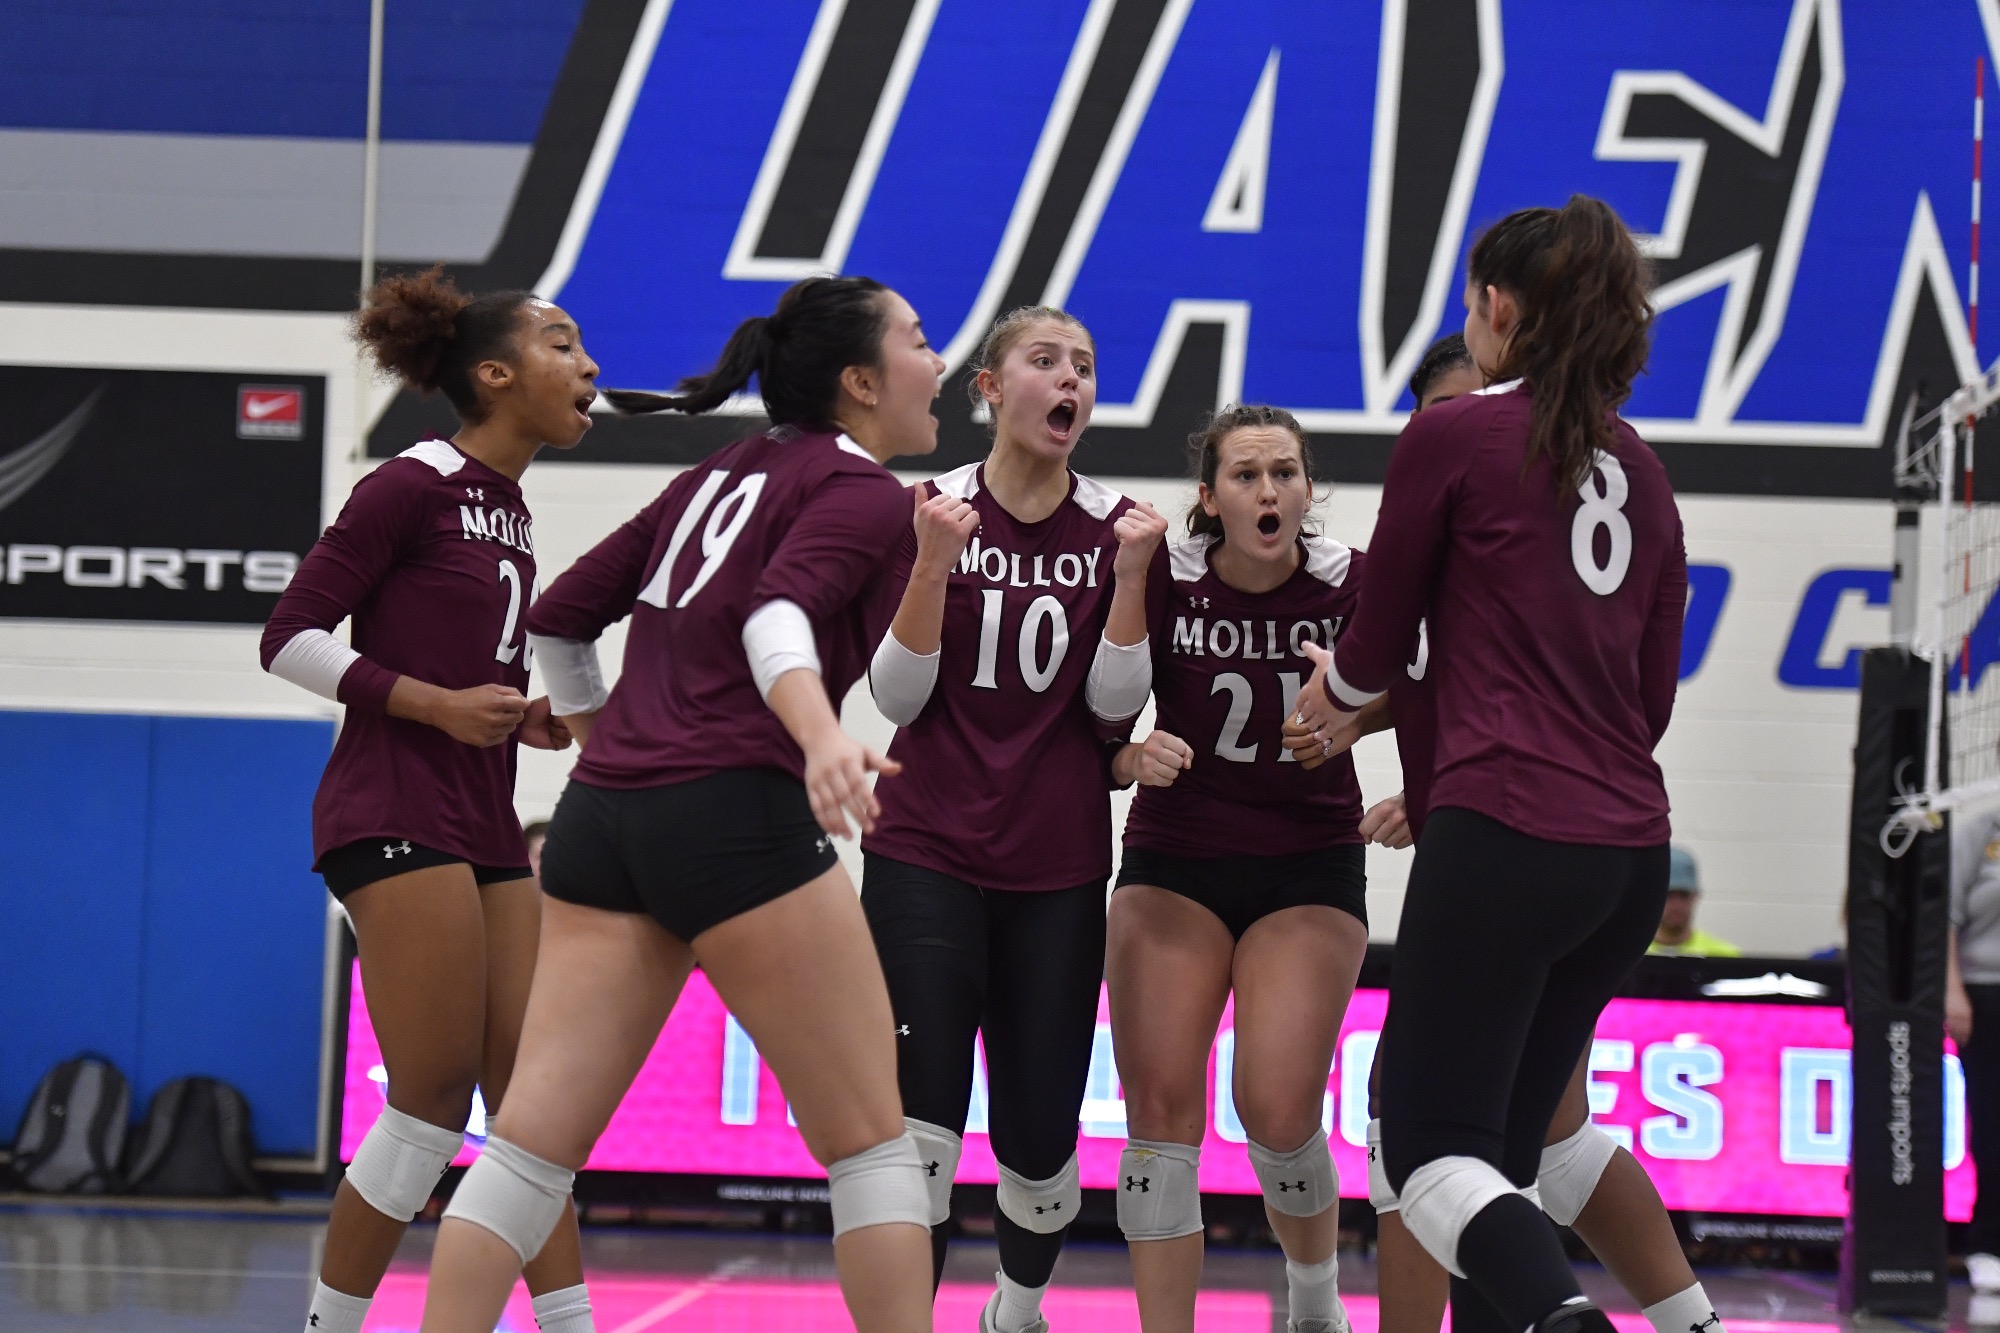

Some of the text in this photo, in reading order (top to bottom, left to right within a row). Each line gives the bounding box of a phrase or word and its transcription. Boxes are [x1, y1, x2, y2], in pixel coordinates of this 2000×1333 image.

[636, 469, 767, 609] 19
[1571, 448, 1632, 596] 8
[0, 543, 301, 593] PORTS
[950, 536, 1102, 588] MOLLOY
[970, 589, 1070, 693] 10
[1172, 616, 1344, 660] MOLLOY
